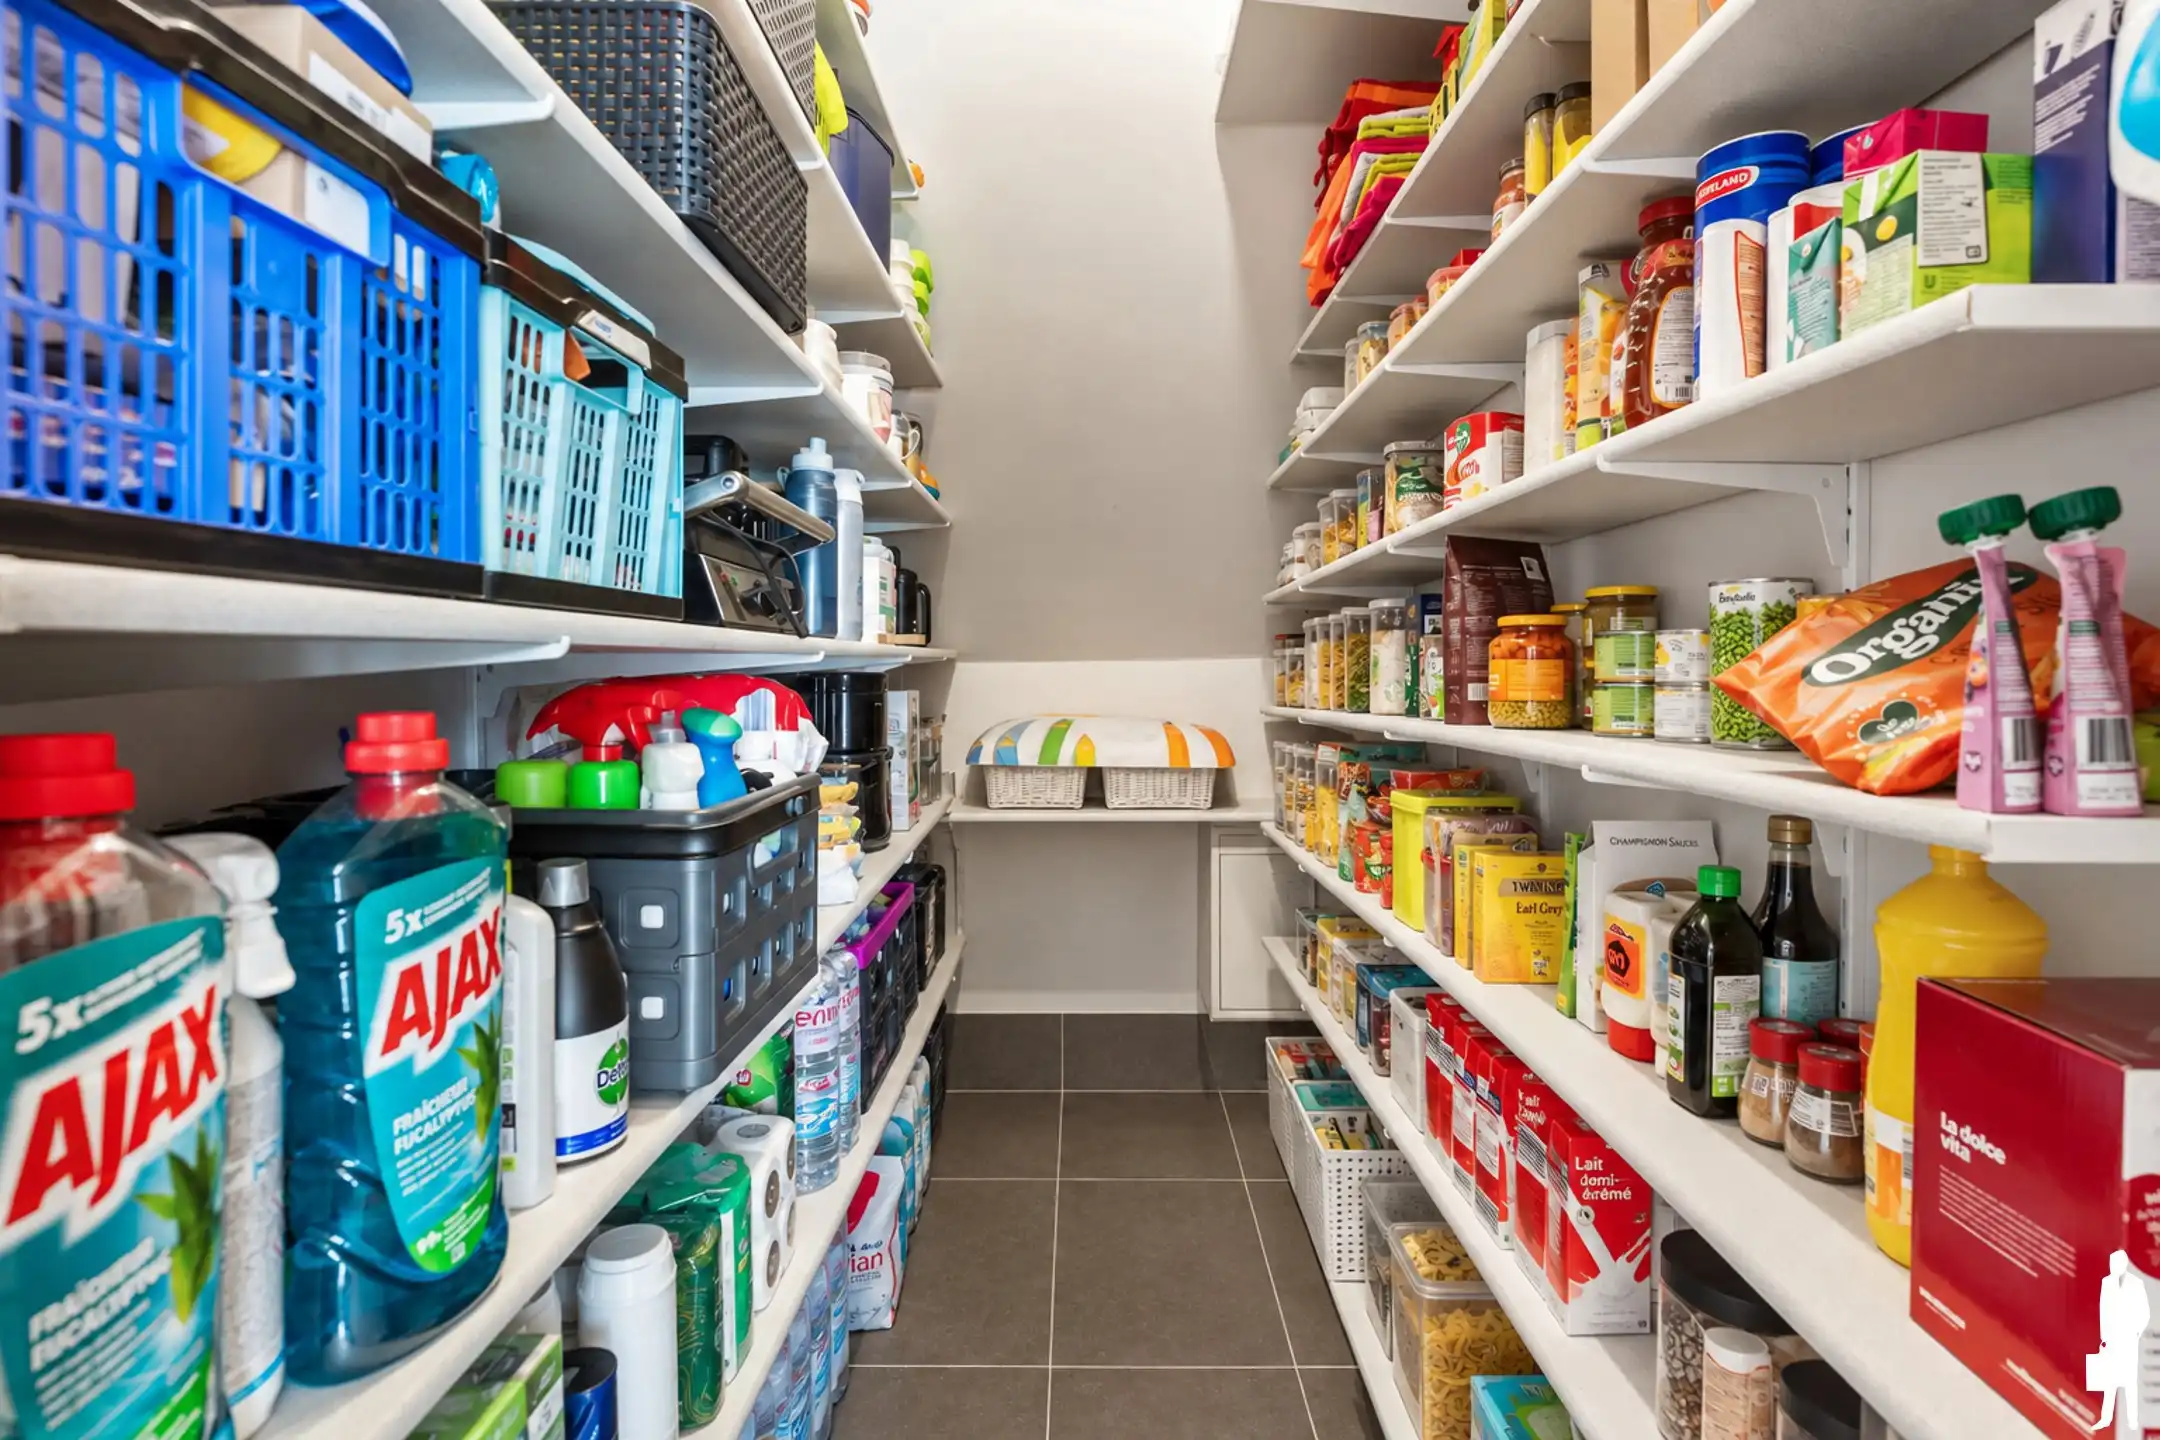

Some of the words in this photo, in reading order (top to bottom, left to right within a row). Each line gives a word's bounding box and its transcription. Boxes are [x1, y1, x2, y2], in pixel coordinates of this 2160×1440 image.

[384, 907, 424, 944] 5x
[1516, 901, 1537, 915] Earl
[380, 904, 502, 1058] AJAX
[15, 996, 84, 1055] 5x
[4, 981, 218, 1228] AJAX
[1940, 1110, 1958, 1136] La
[1960, 1124, 2006, 1165] dolce
[1940, 1132, 1971, 1164] vita
[1575, 1156, 1604, 1171] Lait
